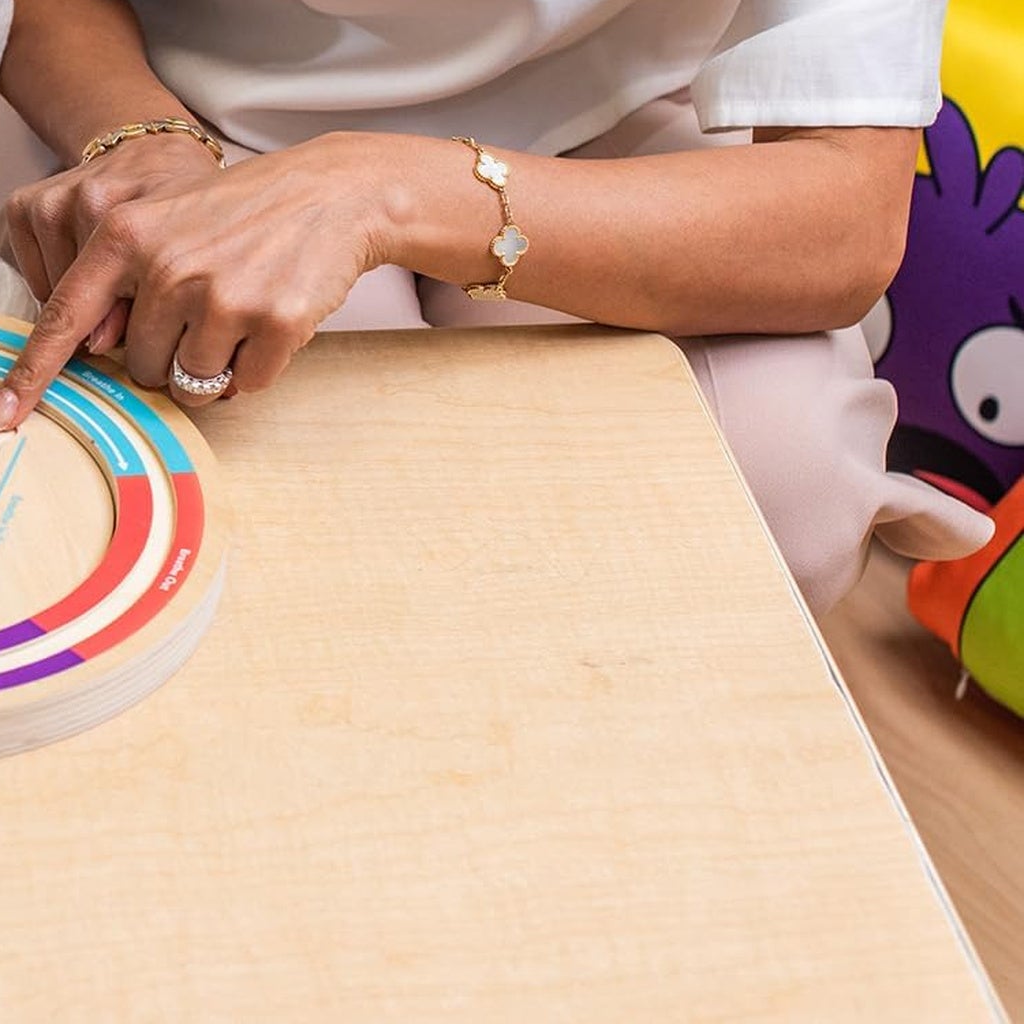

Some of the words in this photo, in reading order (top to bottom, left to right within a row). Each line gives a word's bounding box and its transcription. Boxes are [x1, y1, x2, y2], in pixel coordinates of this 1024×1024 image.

[81, 370, 116, 394] Breathe
[114, 391, 125, 401] In
[168, 548, 192, 575] Breathe
[159, 575, 177, 592] Out
